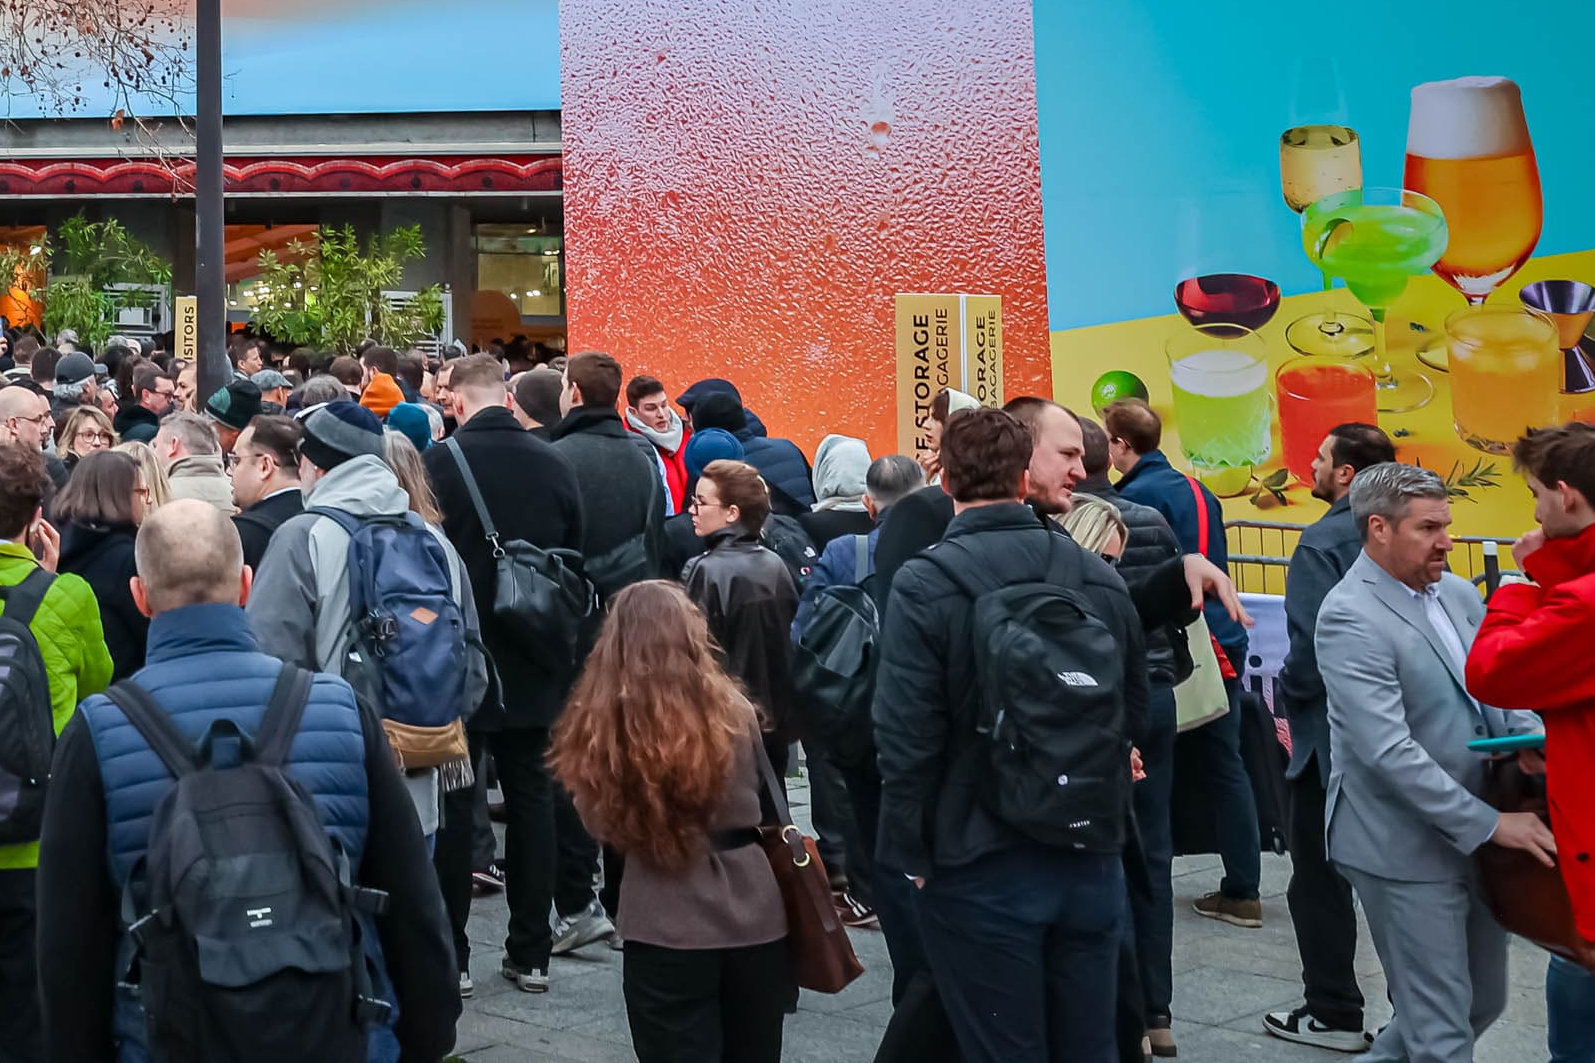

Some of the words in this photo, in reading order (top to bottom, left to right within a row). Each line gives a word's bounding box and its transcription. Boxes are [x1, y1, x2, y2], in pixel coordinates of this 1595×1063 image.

[183, 306, 194, 360] ISITORS
[913, 314, 930, 429] STORAGE
[935, 308, 948, 387] GAGERIE
[976, 316, 987, 403] ORAGE
